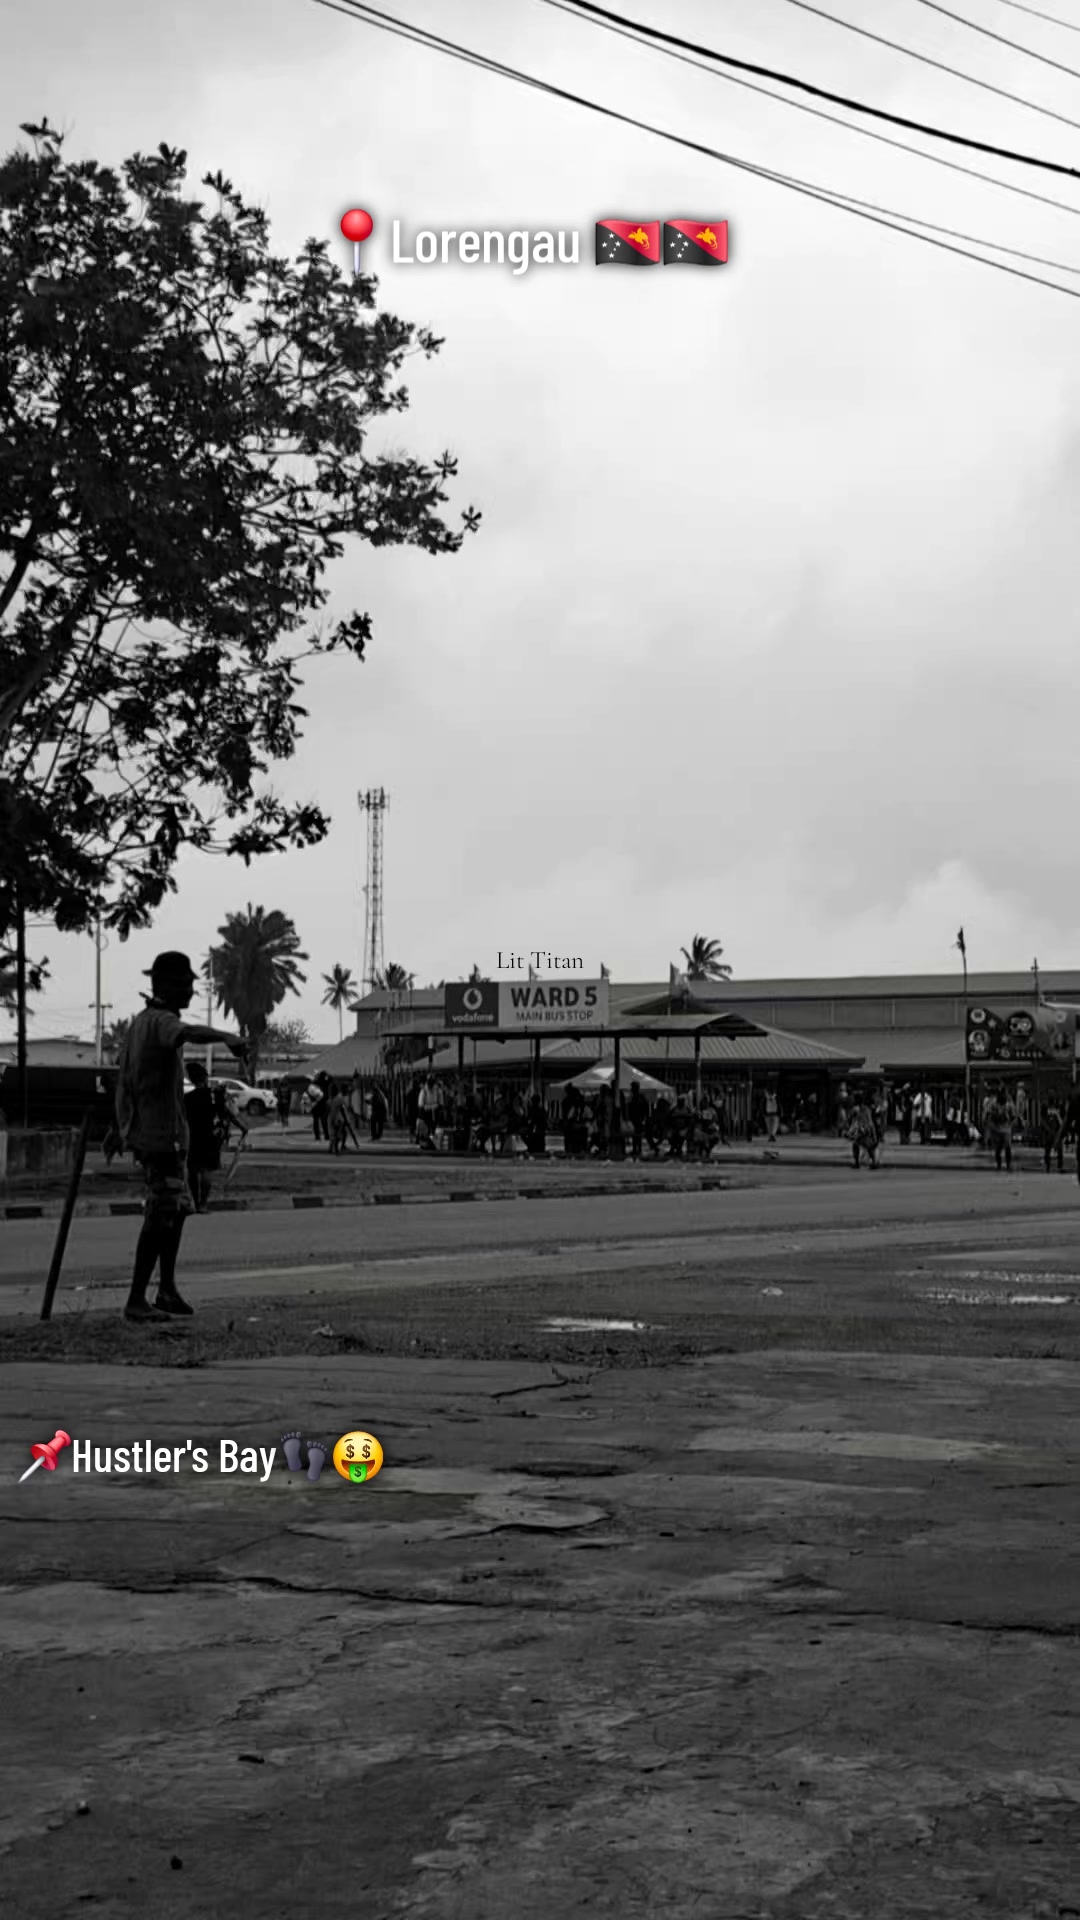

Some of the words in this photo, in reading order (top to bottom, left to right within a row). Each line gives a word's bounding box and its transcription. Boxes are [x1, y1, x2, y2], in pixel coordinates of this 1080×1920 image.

[511, 986, 579, 1007] WARD
[585, 986, 597, 1006] 5
[452, 1012, 494, 1023] vodafone
[516, 1011, 543, 1022] MAIN
[545, 1011, 565, 1021] BUS
[567, 1010, 593, 1021] STOP
